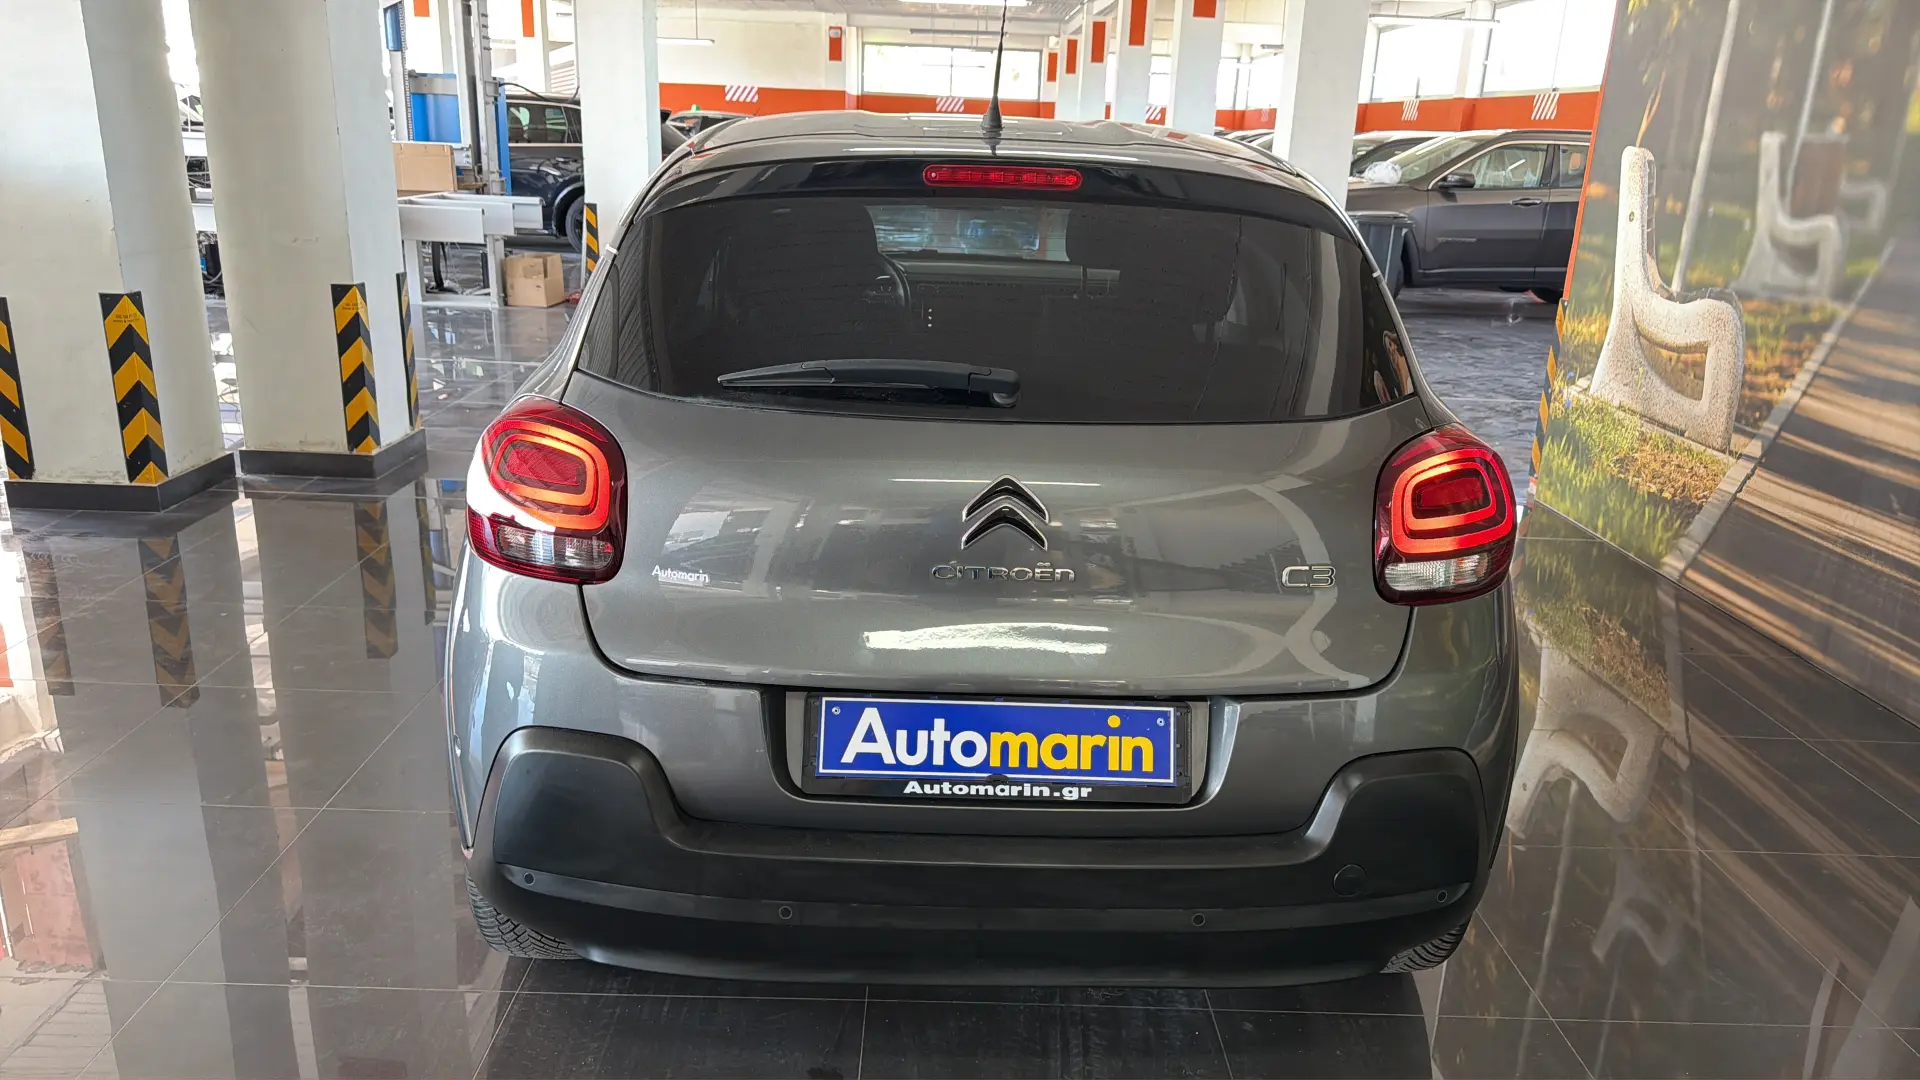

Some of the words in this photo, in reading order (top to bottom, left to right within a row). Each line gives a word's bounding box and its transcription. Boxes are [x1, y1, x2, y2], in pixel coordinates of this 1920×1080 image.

[651, 564, 709, 583] Automarin
[1281, 565, 1337, 588] C3
[840, 706, 1154, 772] Automarin
[903, 780, 1093, 801] Automarin.gr
